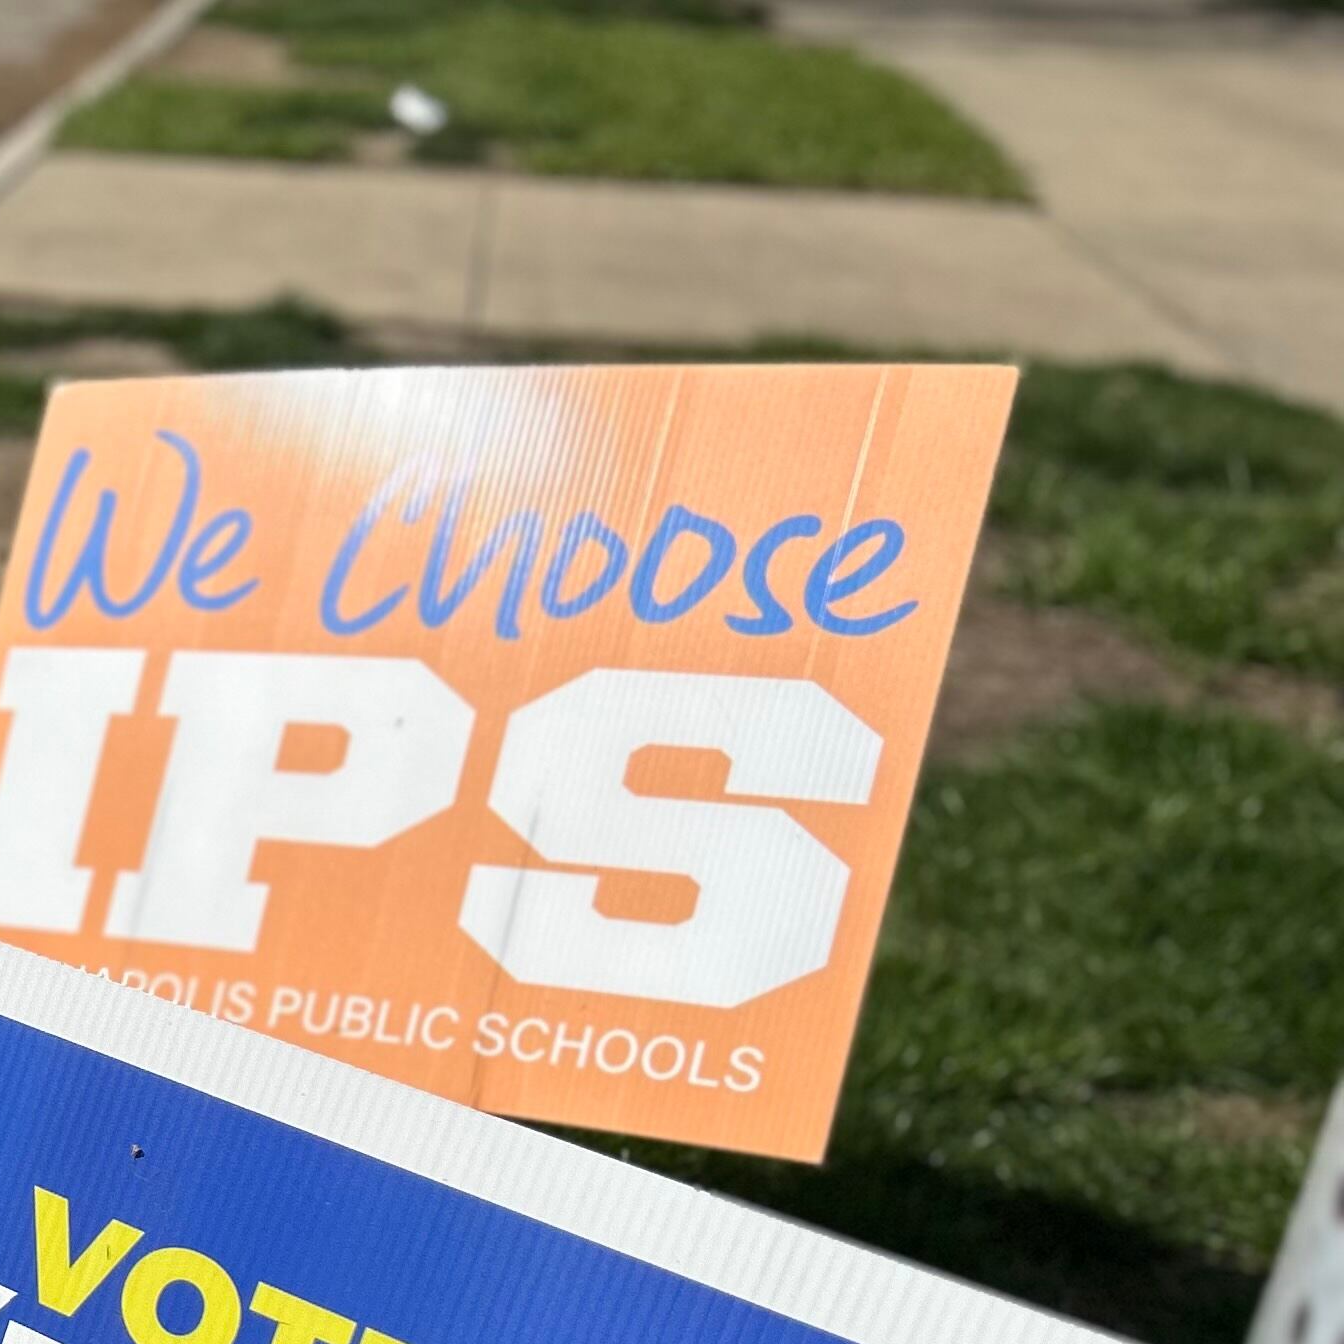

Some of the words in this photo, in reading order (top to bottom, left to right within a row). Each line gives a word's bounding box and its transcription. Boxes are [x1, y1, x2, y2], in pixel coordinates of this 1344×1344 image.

[23, 429, 259, 629] We
[320, 455, 920, 641] Choose
[267, 987, 457, 1052] PUBLIC
[473, 1012, 765, 1093] SCHOOLS
